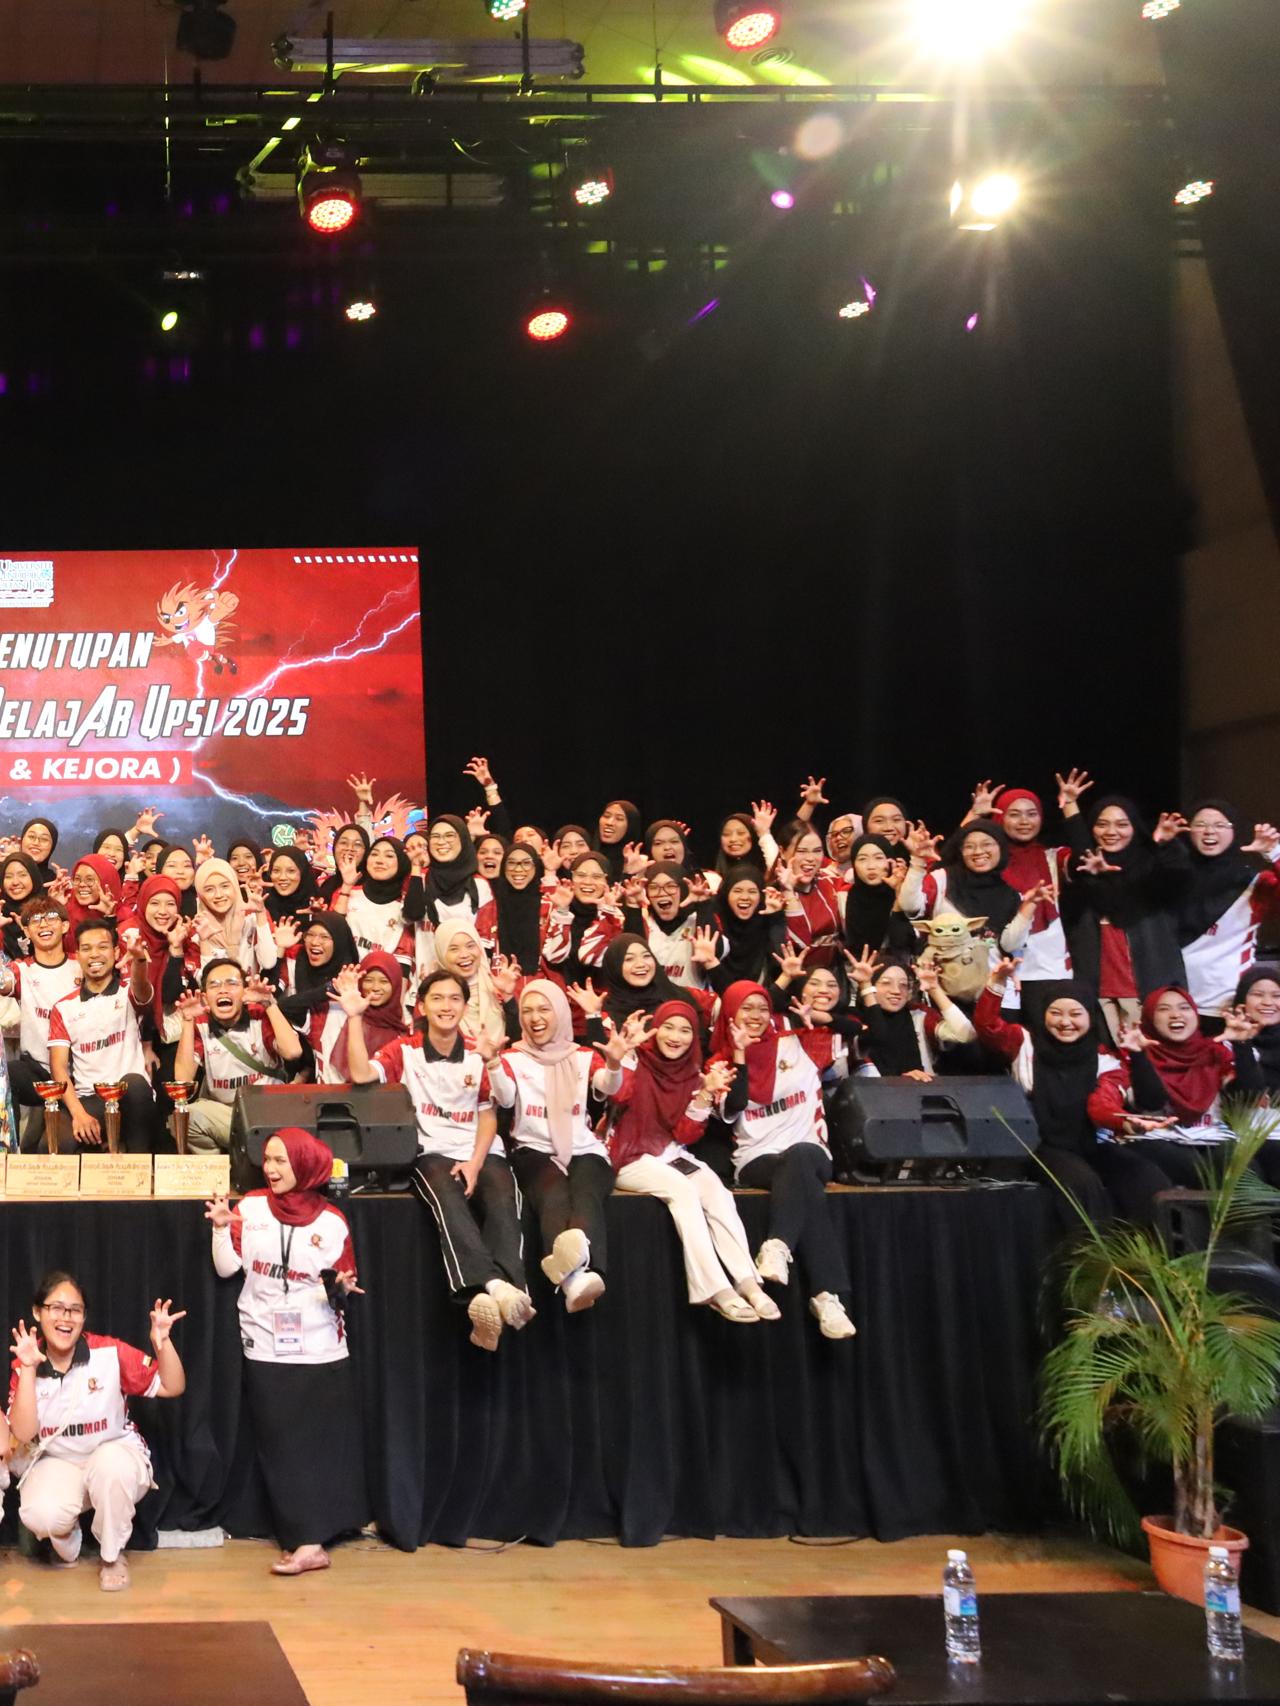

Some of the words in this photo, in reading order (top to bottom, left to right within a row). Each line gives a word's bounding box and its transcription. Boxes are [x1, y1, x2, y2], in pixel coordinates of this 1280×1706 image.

[139, 684, 220, 741] UPSI
[223, 697, 310, 737] 2025
[9, 758, 32, 780] &
[42, 757, 161, 780] KEJORA
[745, 1090, 806, 1121] UNGKUOMAR
